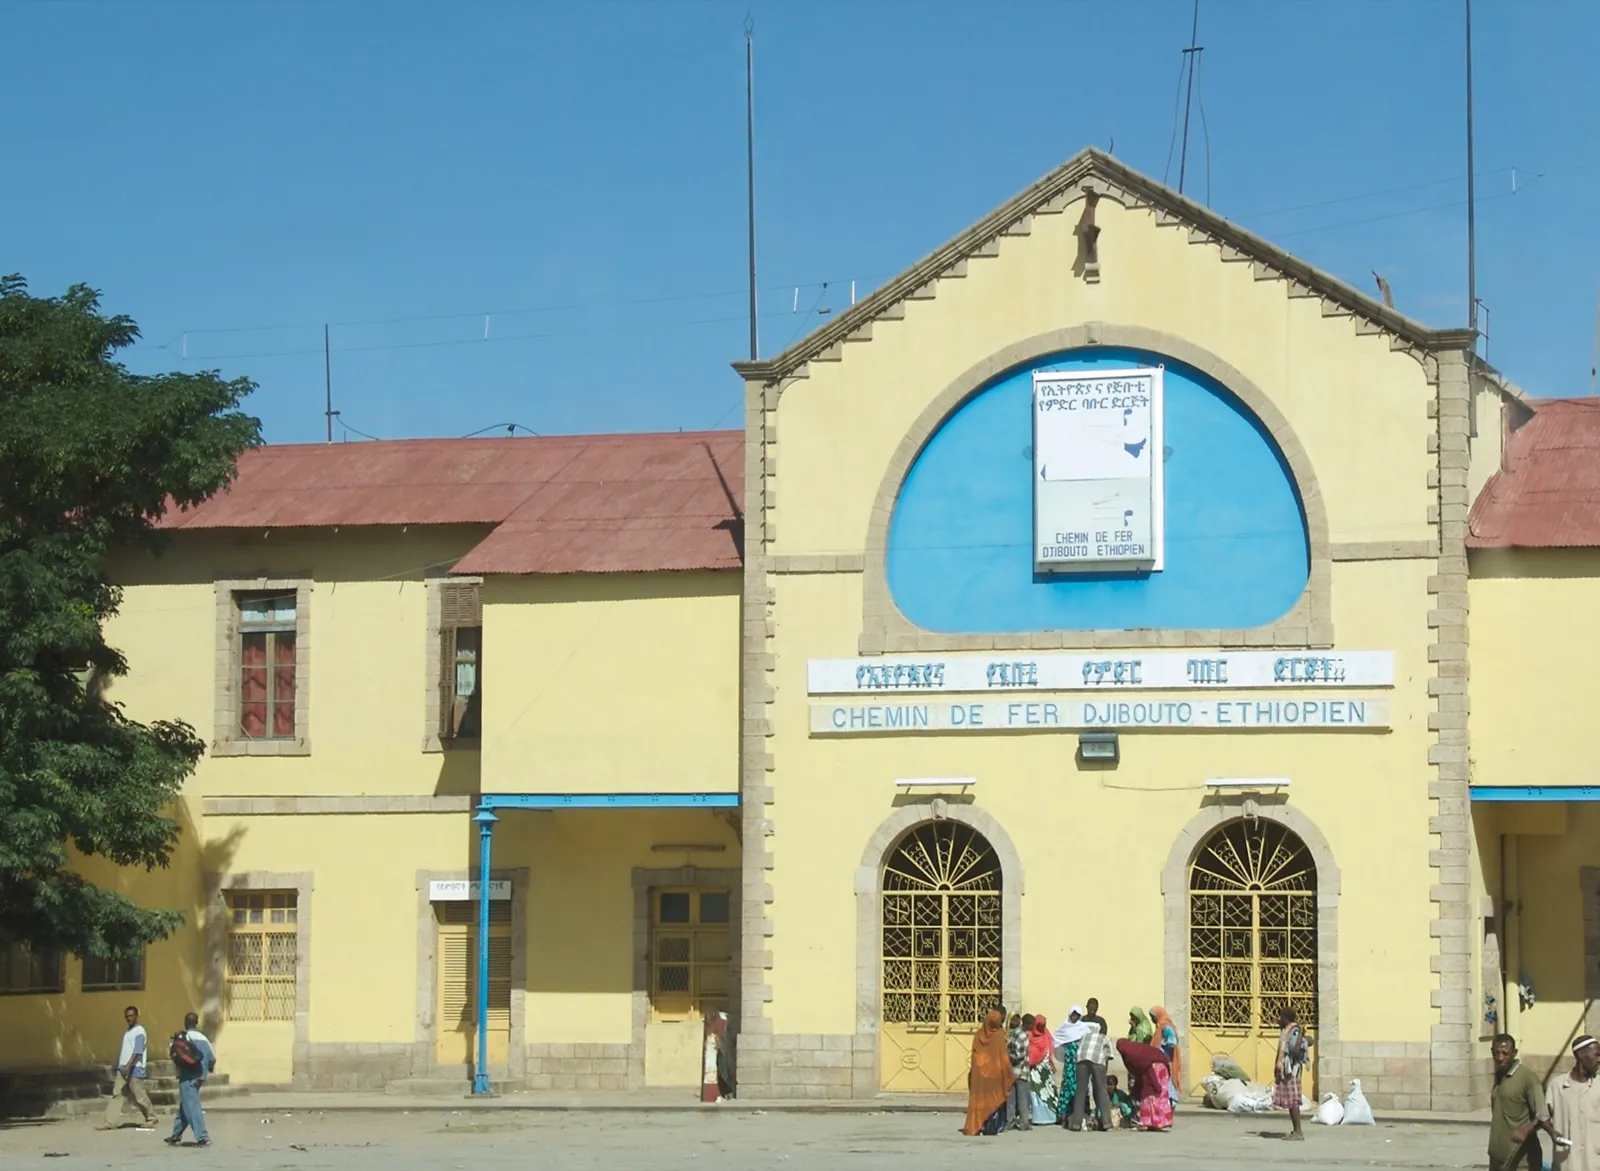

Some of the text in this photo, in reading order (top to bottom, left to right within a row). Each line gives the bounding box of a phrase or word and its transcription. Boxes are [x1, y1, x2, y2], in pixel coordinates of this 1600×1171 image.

[1056, 530, 1133, 544] CHEMIN DE FER
[1042, 543, 1145, 558] DJIBOUTO ETHIOPIEN
[832, 705, 928, 728] CHEMIN
[950, 704, 984, 726] DE
[1008, 703, 1059, 725] FER
